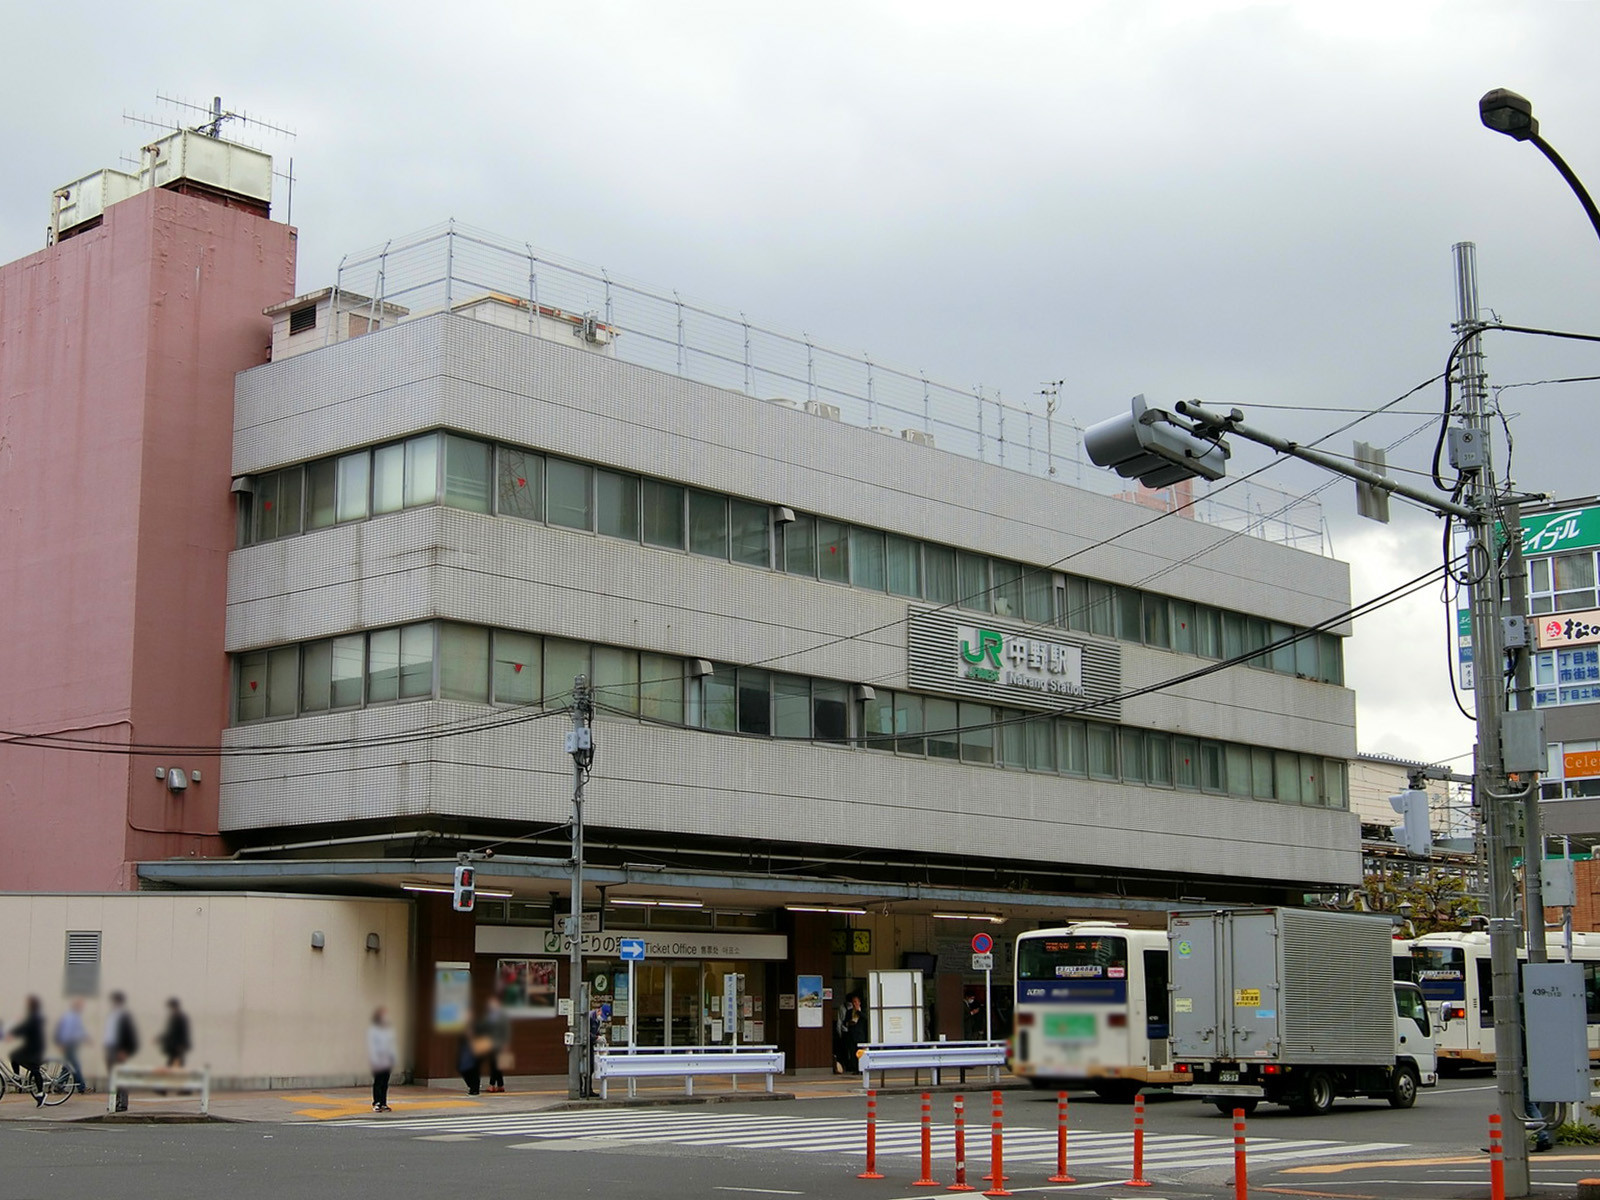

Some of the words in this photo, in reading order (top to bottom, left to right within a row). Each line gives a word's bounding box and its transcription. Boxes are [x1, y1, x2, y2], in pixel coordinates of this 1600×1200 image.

[960, 629, 1003, 668] JR
[1007, 637, 1067, 674] 中野駅
[1008, 671, 1045, 691] Nakano
[1049, 679, 1085, 696] Station
[1564, 755, 1600, 769] Cele
[645, 942, 670, 954] Ticket
[672, 942, 697, 955] Office
